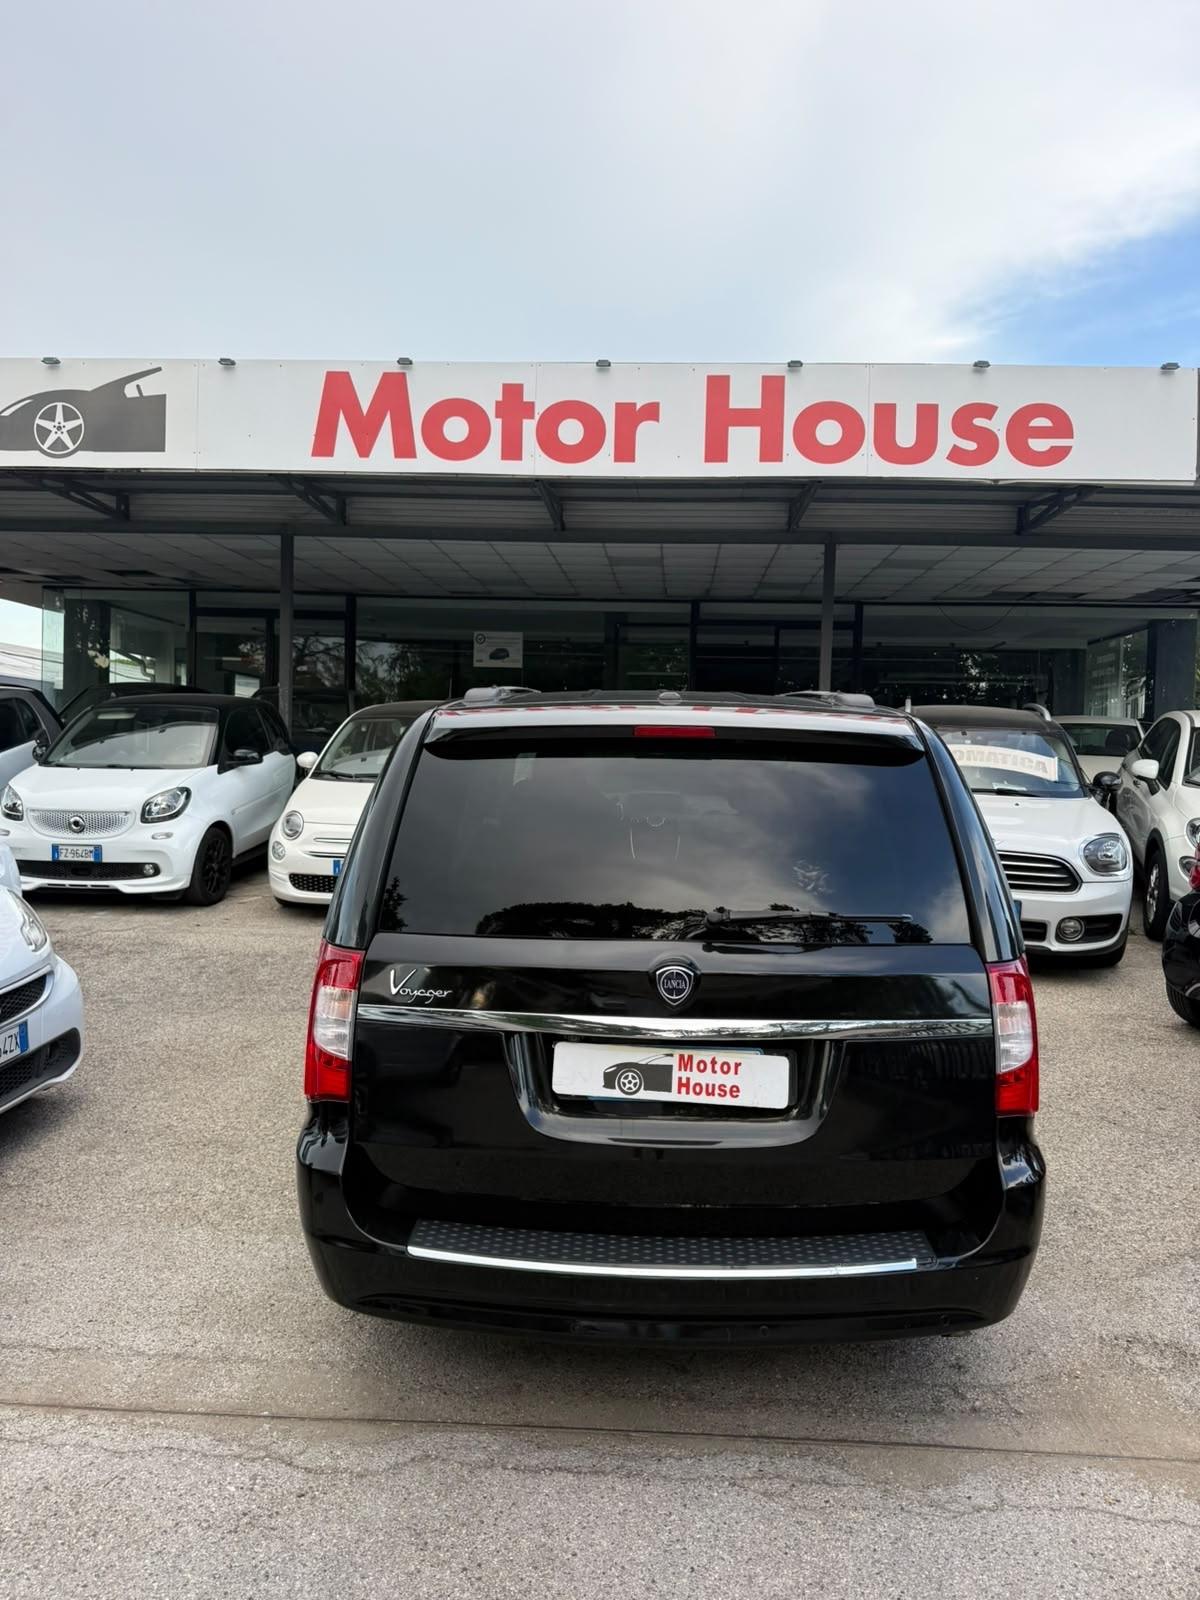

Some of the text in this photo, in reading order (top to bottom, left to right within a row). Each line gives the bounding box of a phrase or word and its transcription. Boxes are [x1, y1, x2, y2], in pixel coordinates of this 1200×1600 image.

[311, 370, 1075, 467] Motor House
[390, 968, 453, 1004] Voyager
[663, 979, 687, 989] LANCIA
[0, 1031, 20, 1058] 4ZX
[677, 1053, 742, 1075] Motor
[677, 1076, 741, 1098] House
